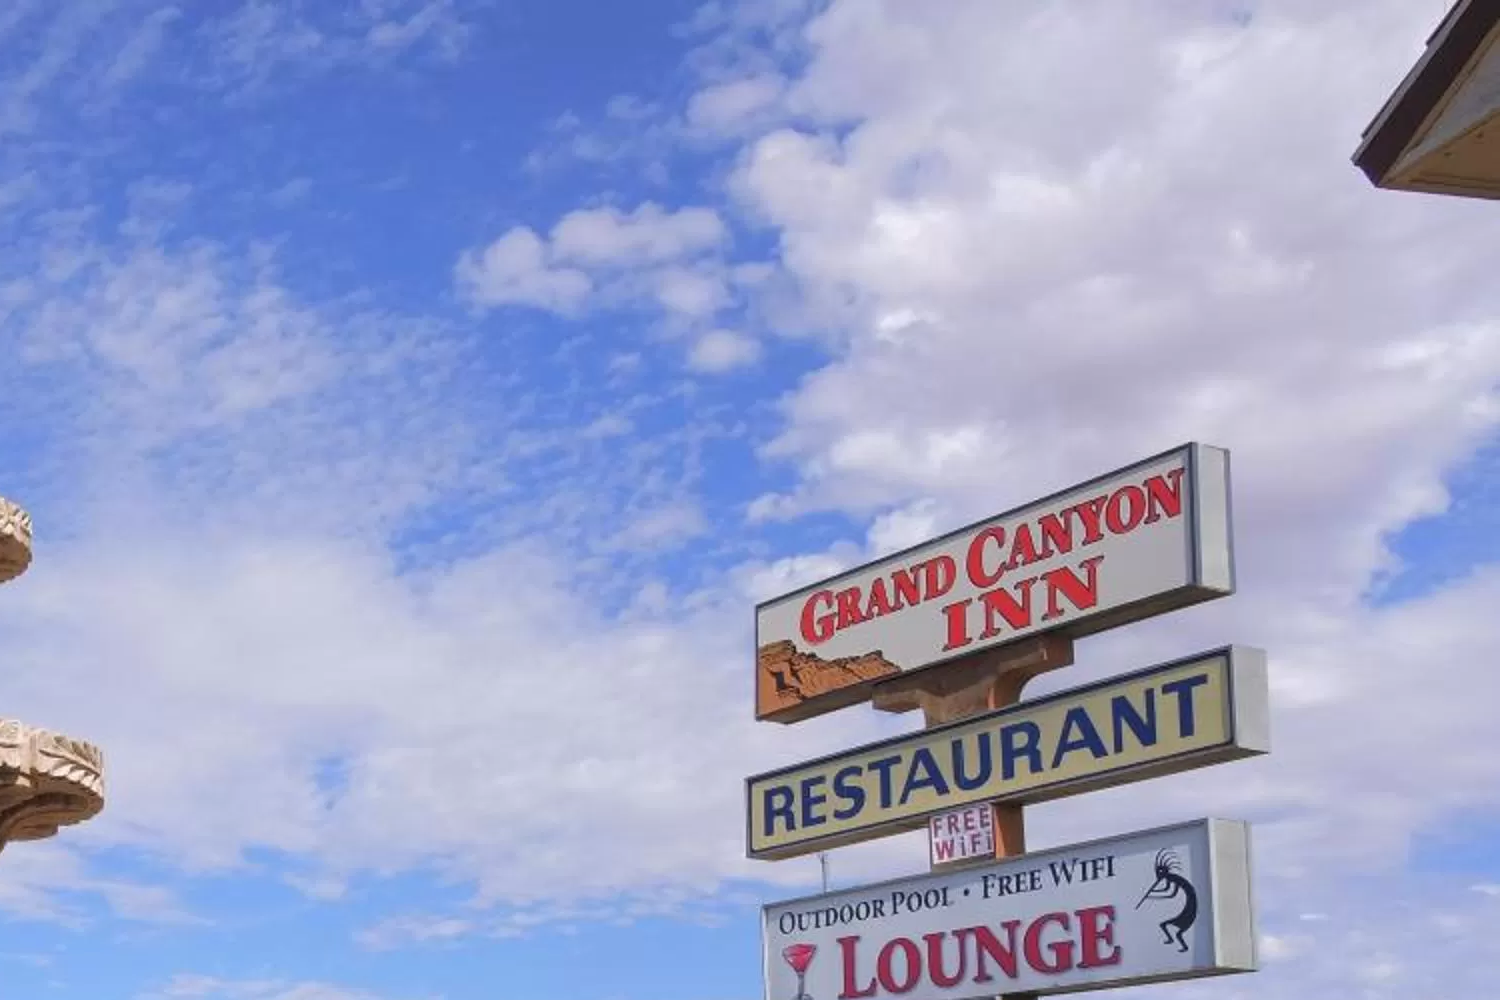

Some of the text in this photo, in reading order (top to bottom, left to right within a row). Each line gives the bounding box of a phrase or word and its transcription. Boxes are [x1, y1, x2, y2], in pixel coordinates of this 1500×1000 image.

[800, 468, 1185, 646] GRAND CANYON
[942, 556, 1104, 652] INN
[763, 674, 1208, 837] RESTAURANT
[932, 803, 990, 838] FREE
[779, 855, 1116, 935] OUTDOOR POOL FREE WIFI
[837, 905, 1121, 1000] LOUNGE
